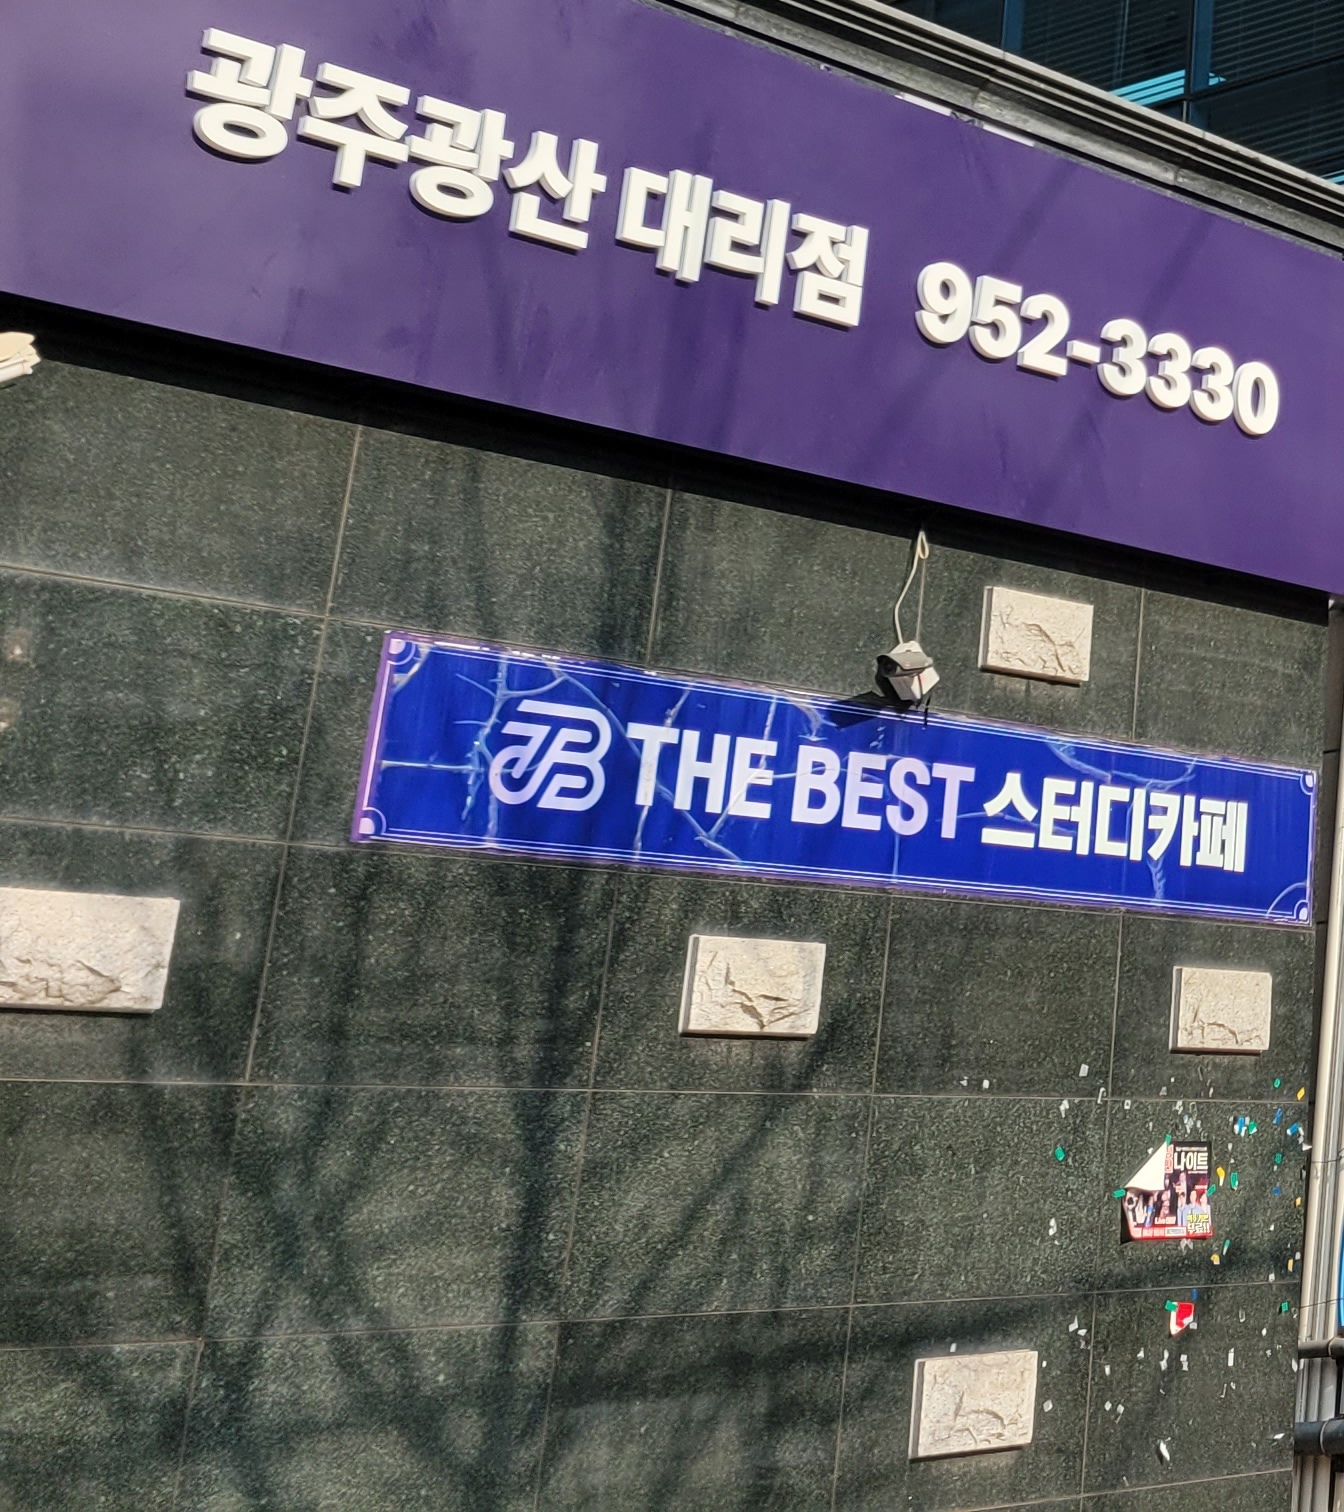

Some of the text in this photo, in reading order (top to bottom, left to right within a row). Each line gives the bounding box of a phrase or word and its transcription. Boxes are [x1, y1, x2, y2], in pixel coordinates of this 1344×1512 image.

[186, 26, 1281, 436] 광주광산 대리점 952-3330
[627, 721, 1249, 875] THE BEST 스터디카페
[1173, 1151, 1209, 1171] 나이트
